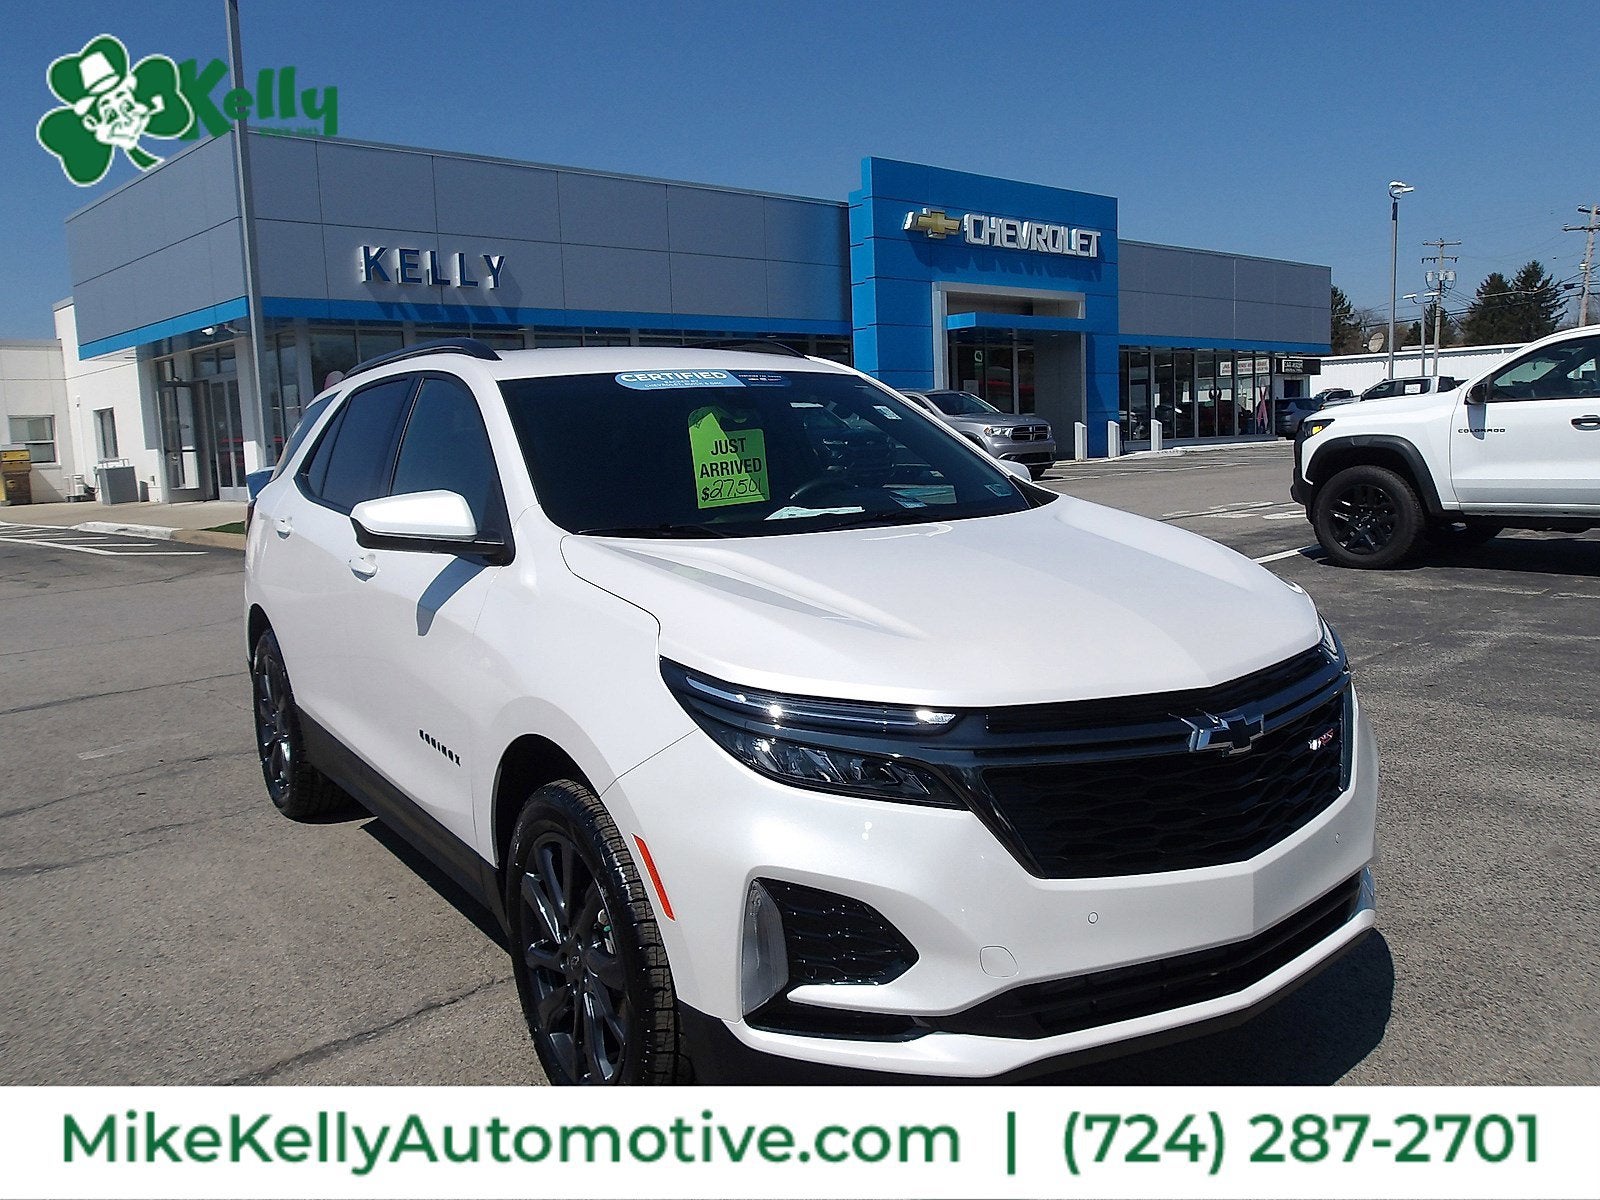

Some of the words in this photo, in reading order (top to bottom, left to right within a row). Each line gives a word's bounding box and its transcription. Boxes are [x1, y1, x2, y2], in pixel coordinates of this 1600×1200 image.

[963, 213, 1101, 258] CHEVROLET
[359, 246, 506, 289] KELLY
[620, 371, 728, 382] CERTIFIED
[711, 437, 746, 455] JUST
[699, 457, 762, 479] ARRIVED
[419, 729, 461, 767] EQUINOX
